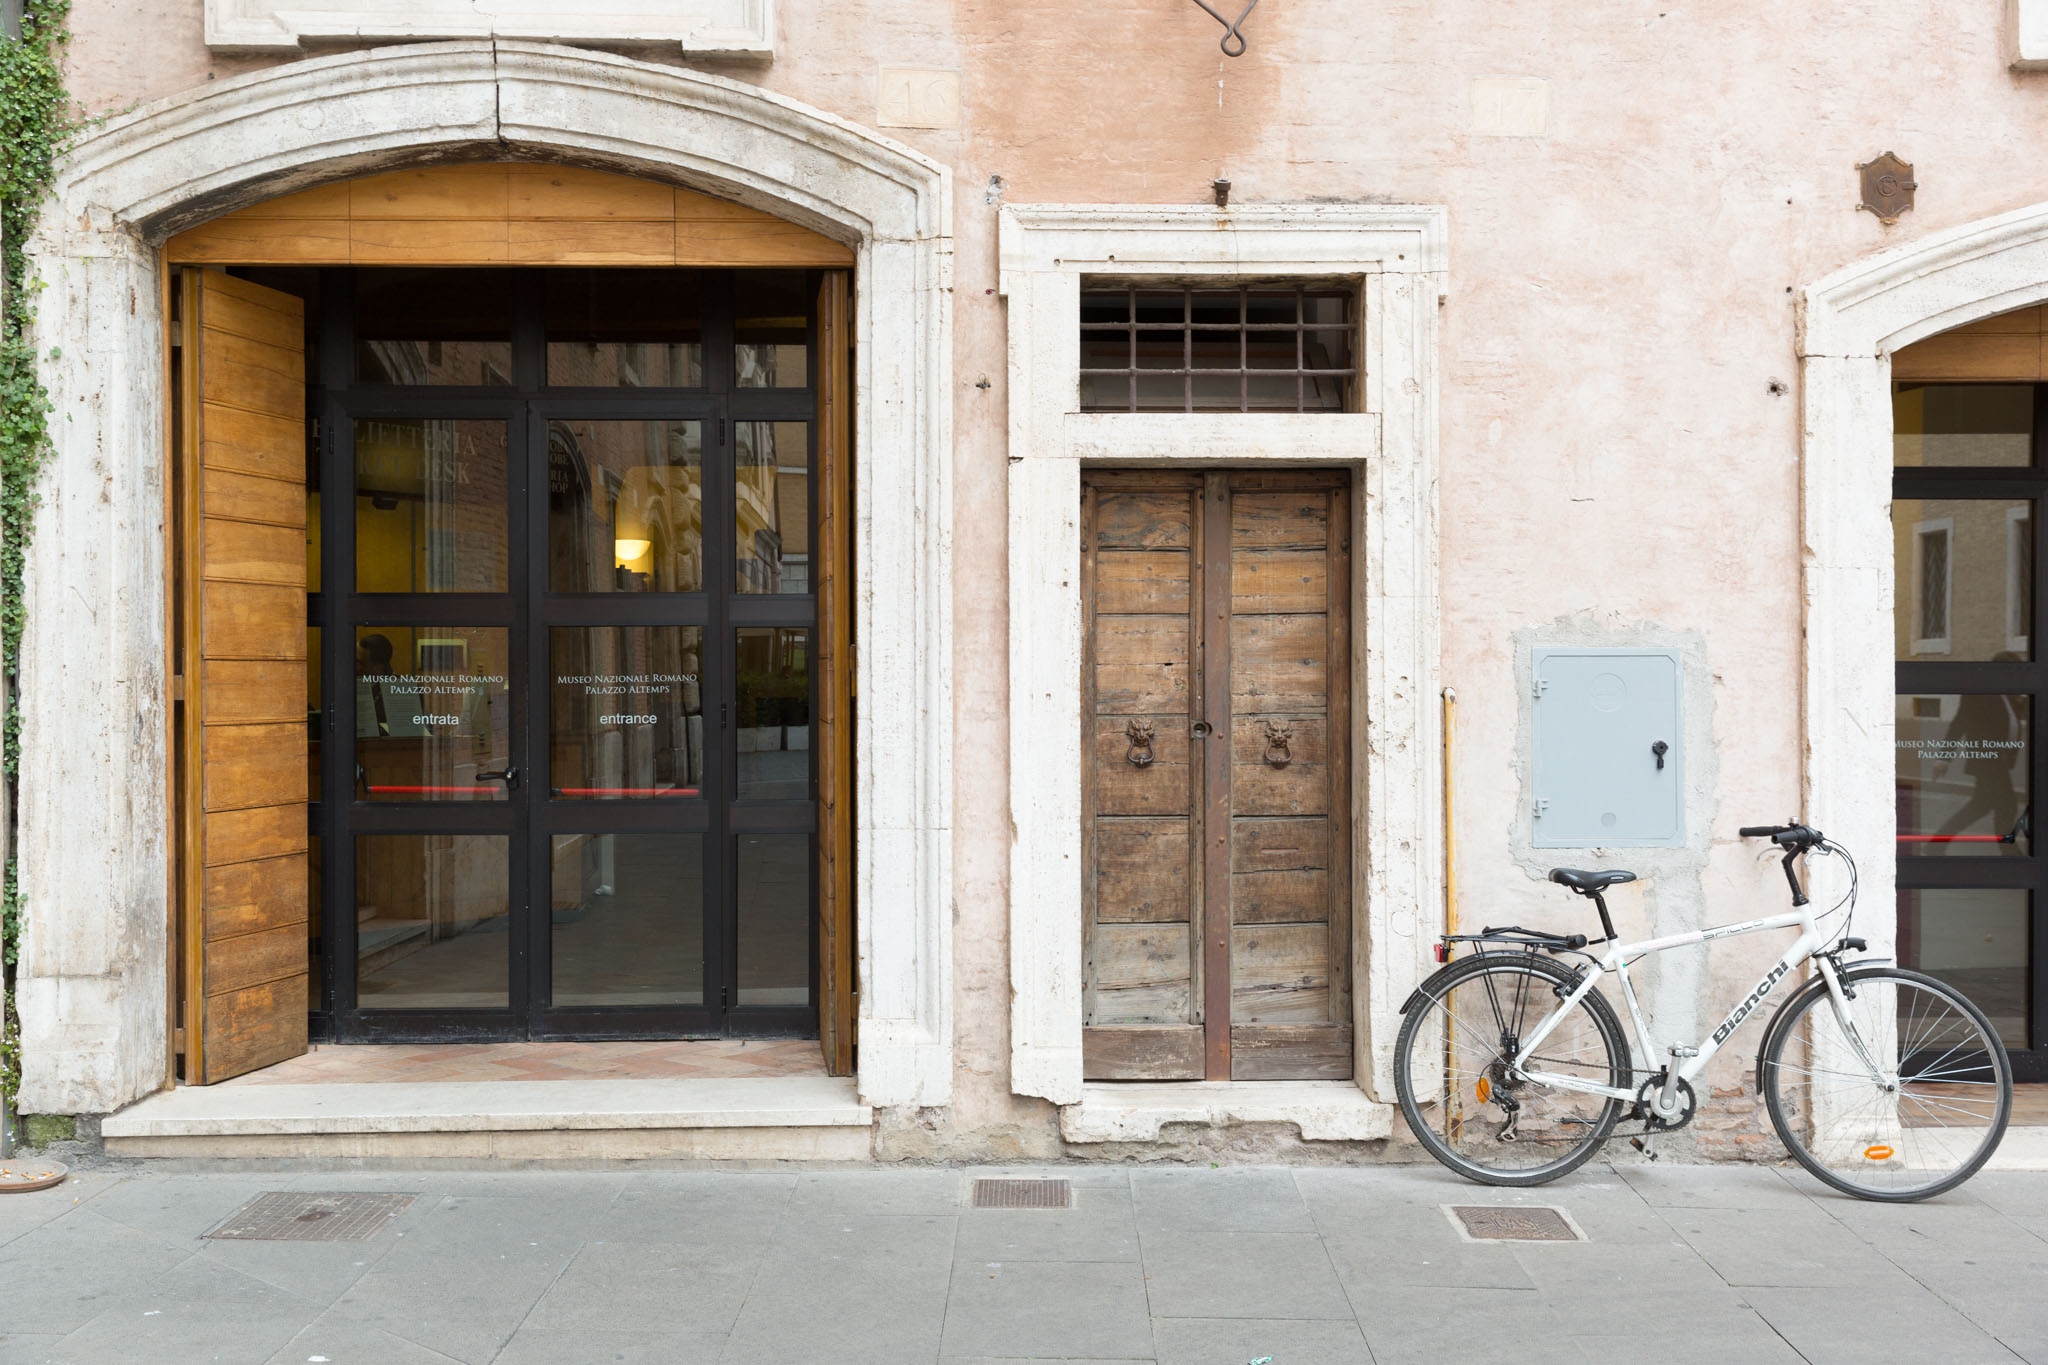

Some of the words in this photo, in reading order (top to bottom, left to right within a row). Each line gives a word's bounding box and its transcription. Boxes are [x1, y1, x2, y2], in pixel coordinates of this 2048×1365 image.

[362, 674, 397, 683] MUSEO
[400, 674, 455, 683] NAZIONALE
[458, 674, 504, 683] ROMANO
[557, 676, 592, 684] MUSEO
[595, 674, 649, 683] NAZIONALE
[653, 673, 697, 682] ROMANO
[390, 685, 432, 694] PALAZZO
[434, 686, 476, 694] ALTEMPS
[585, 686, 626, 695] PALAZZO
[629, 685, 670, 694] ALTEMPS
[412, 713, 459, 725] entrata
[600, 713, 657, 724] entrance
[1927, 740, 1979, 748] NAZIONALE
[1982, 740, 2025, 748] ROMANO
[1917, 750, 1956, 759] PALAZZO
[1959, 751, 1999, 759] ALTEMPS
[1712, 959, 1789, 1045] Bianchi
